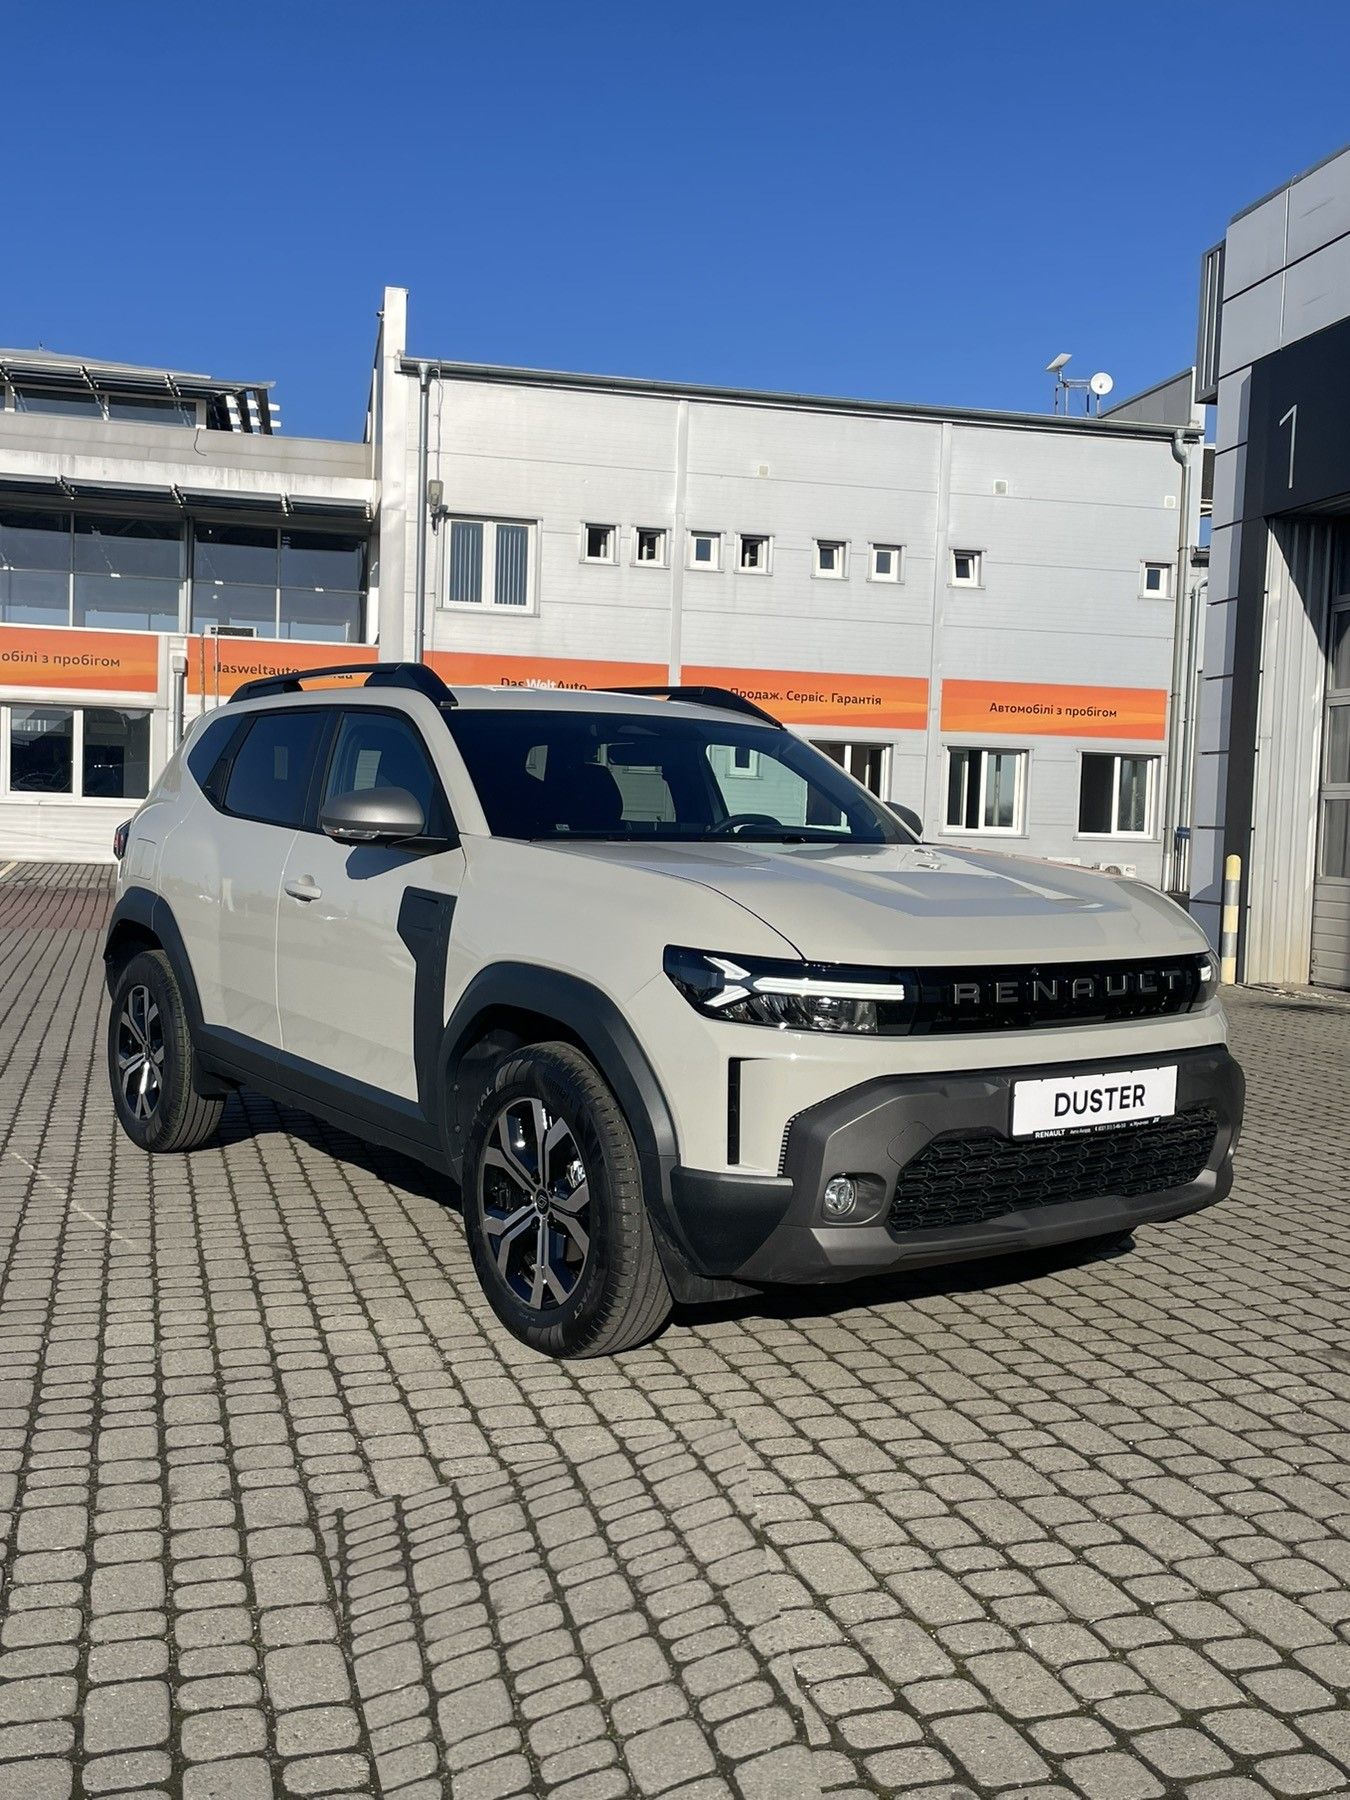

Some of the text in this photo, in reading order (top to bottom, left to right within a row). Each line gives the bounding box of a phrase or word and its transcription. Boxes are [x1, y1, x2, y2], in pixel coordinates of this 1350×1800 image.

[1279, 404, 1298, 489] 1
[42, 655, 49, 664] з
[53, 654, 121, 667] пробігом
[730, 687, 882, 706] Продаж. Сервіс. Гарантія
[989, 702, 1118, 718] Автомобілі з пробігом
[953, 970, 1182, 1005] RENAULT
[1054, 1083, 1147, 1118] DUSTER
[1034, 1128, 1066, 1139] RENAULT
